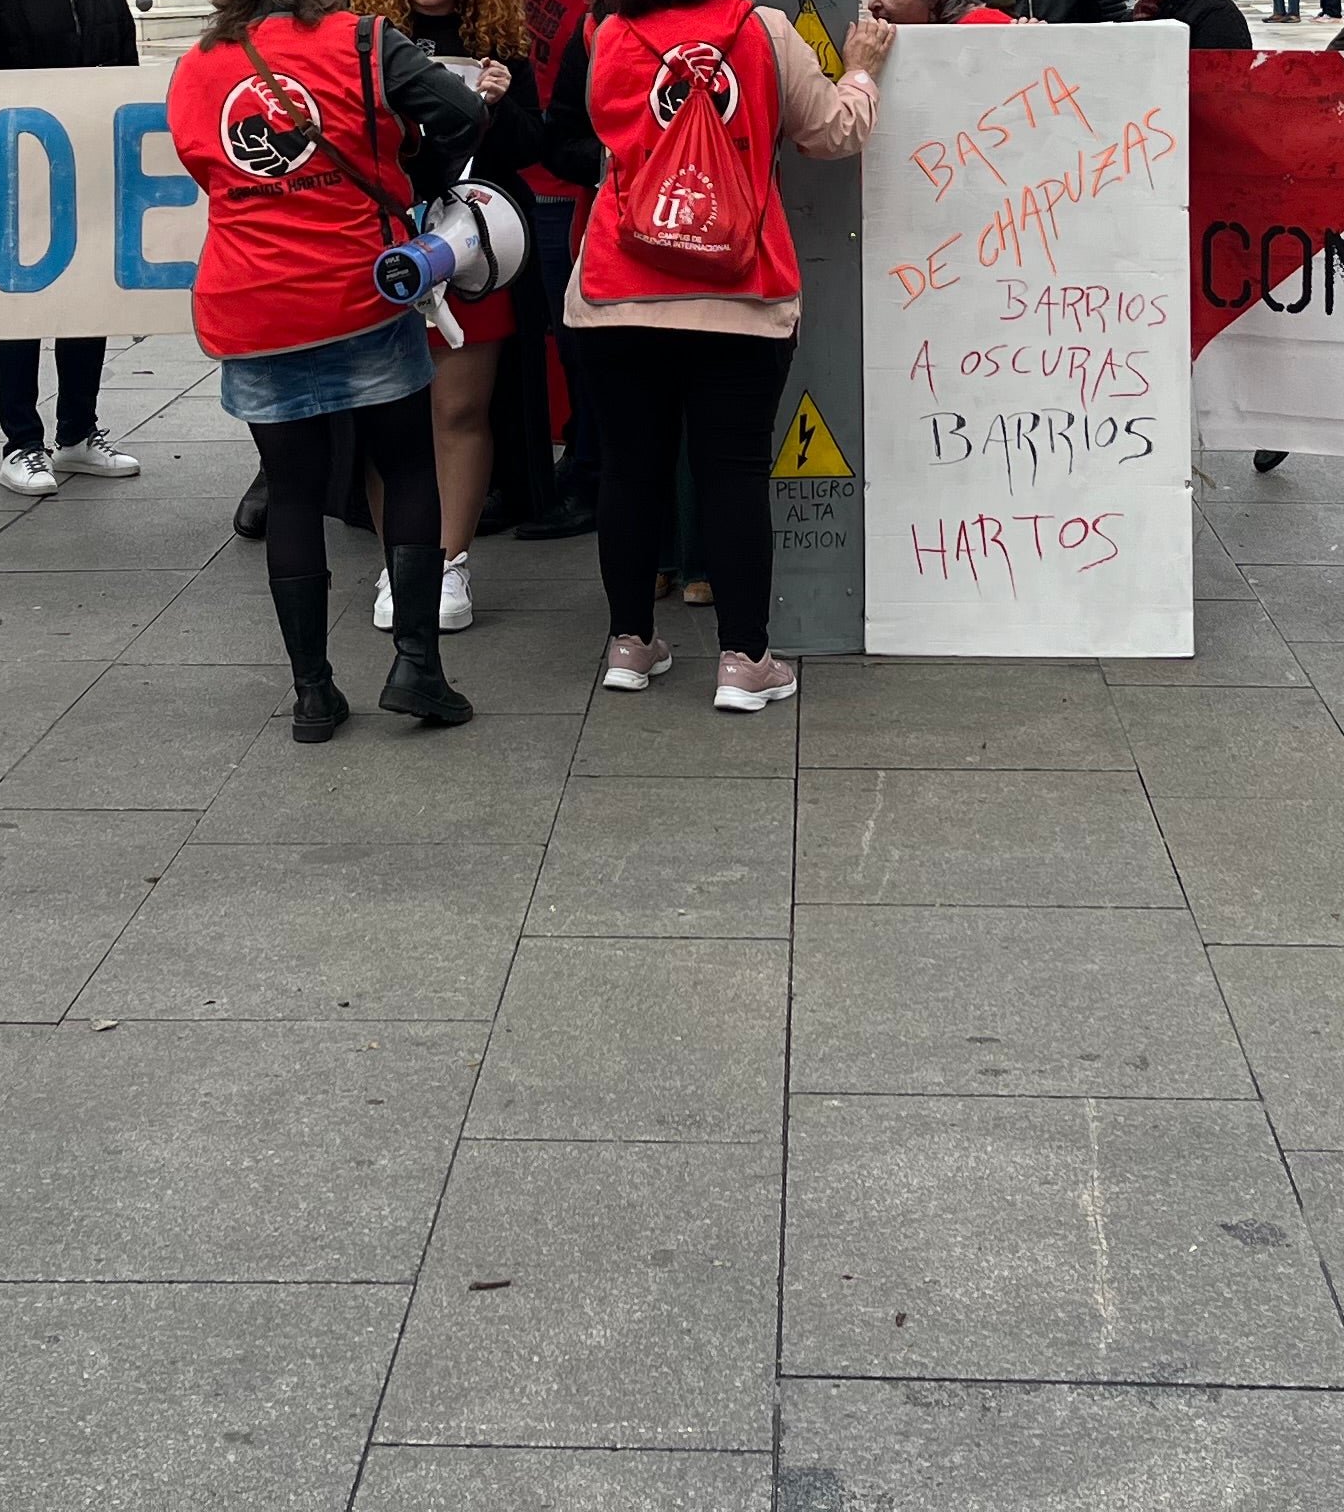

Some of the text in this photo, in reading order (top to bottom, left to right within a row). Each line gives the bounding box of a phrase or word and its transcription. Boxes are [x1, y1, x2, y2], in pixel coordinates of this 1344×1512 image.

[909, 66, 1100, 202] BASTA
[889, 107, 1177, 310] DE CHAPUZAS
[996, 279, 1168, 336] BARRIOS
[910, 340, 1150, 413] A OSCURAS
[920, 407, 1156, 497] BARRIOS
[775, 479, 855, 500] PELIGRO
[786, 502, 835, 523] ALTA
[771, 530, 848, 549] TENSION
[911, 513, 1125, 598] HARTOS
